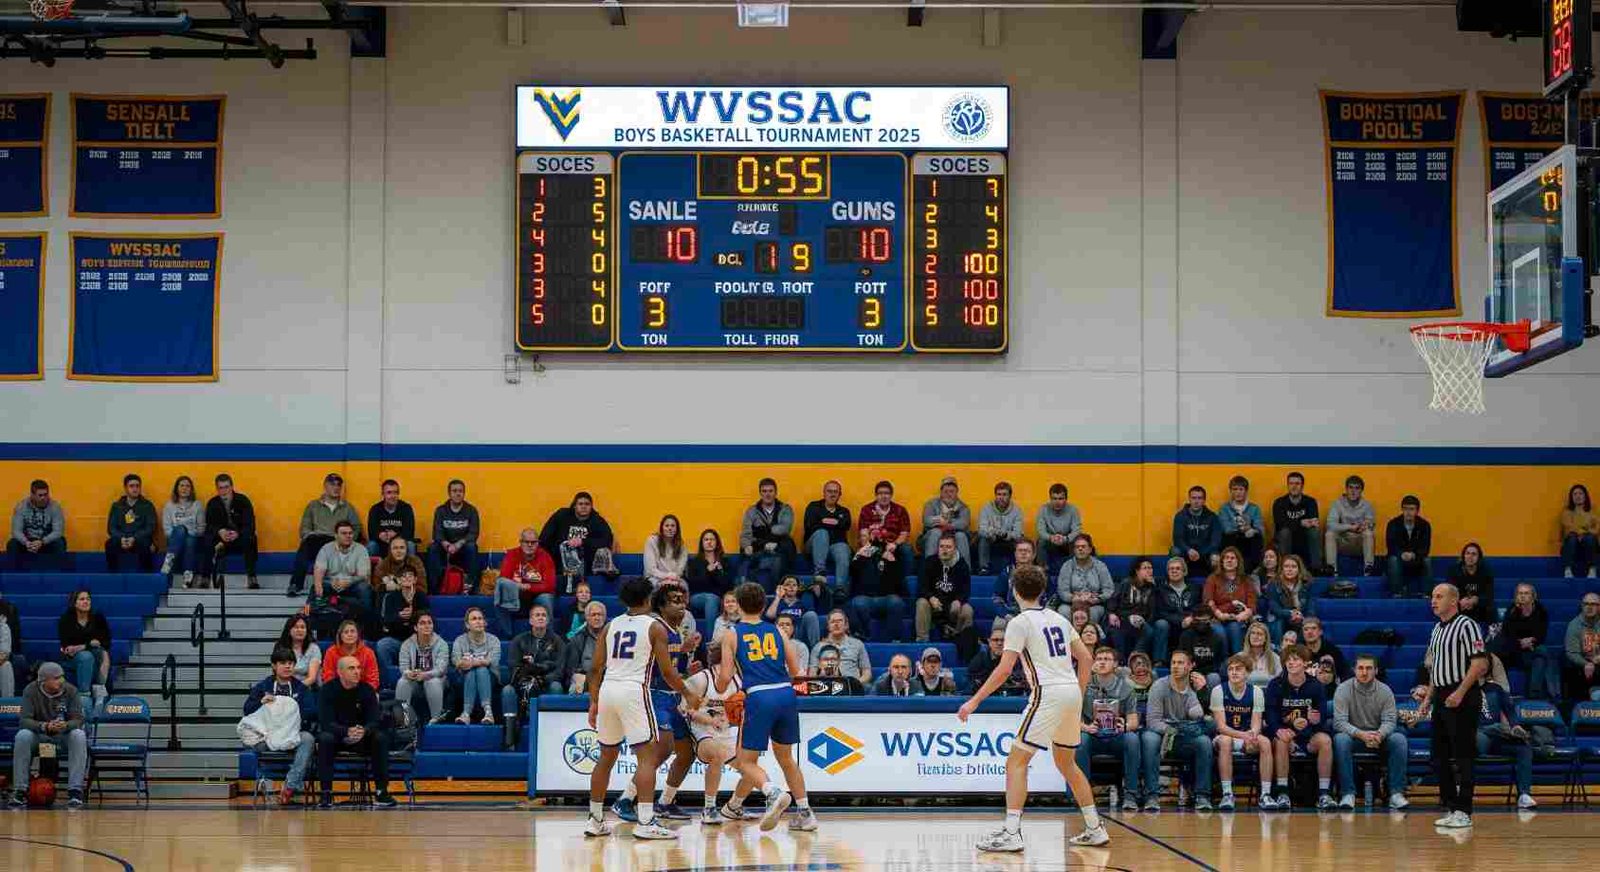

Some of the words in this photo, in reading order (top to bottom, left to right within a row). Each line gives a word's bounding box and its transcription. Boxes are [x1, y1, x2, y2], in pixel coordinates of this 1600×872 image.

[656, 90, 872, 124] WVSSAC
[614, 128, 656, 142] BOYS
[661, 128, 753, 143] BASKETALL
[758, 128, 873, 143] TOURNAMENT
[878, 128, 921, 143] 2025
[536, 157, 595, 172] SOCES
[737, 156, 822, 193] 0:55
[930, 158, 990, 173] SOCES
[540, 178, 545, 195] 1
[594, 177, 606, 198] 3
[932, 179, 937, 197] 1
[532, 202, 545, 222] 2
[592, 202, 605, 223] 5
[628, 200, 697, 221] SANLE
[832, 200, 896, 221] GUMS
[925, 203, 938, 224] 2
[985, 205, 998, 223] 4
[667, 227, 696, 261] 10
[862, 227, 890, 261] 10
[926, 228, 938, 249] 3
[986, 228, 998, 249] 3
[533, 253, 545, 273] 3
[592, 253, 605, 273] 0
[792, 243, 809, 271] 9
[925, 254, 937, 274] 2
[964, 253, 998, 274] 100
[533, 278, 545, 298] 3
[926, 279, 938, 299] 3
[964, 279, 998, 300] 100
[532, 304, 544, 324] 5
[592, 303, 605, 325] 0
[648, 297, 665, 327] 3
[864, 297, 880, 327] 3
[925, 304, 938, 325] 5
[964, 304, 998, 325] 100
[641, 333, 668, 346] TON
[724, 333, 757, 346] TOLL
[857, 333, 884, 346] TON
[611, 630, 638, 660] 12
[742, 632, 779, 662] 34
[1043, 626, 1067, 657] 12
